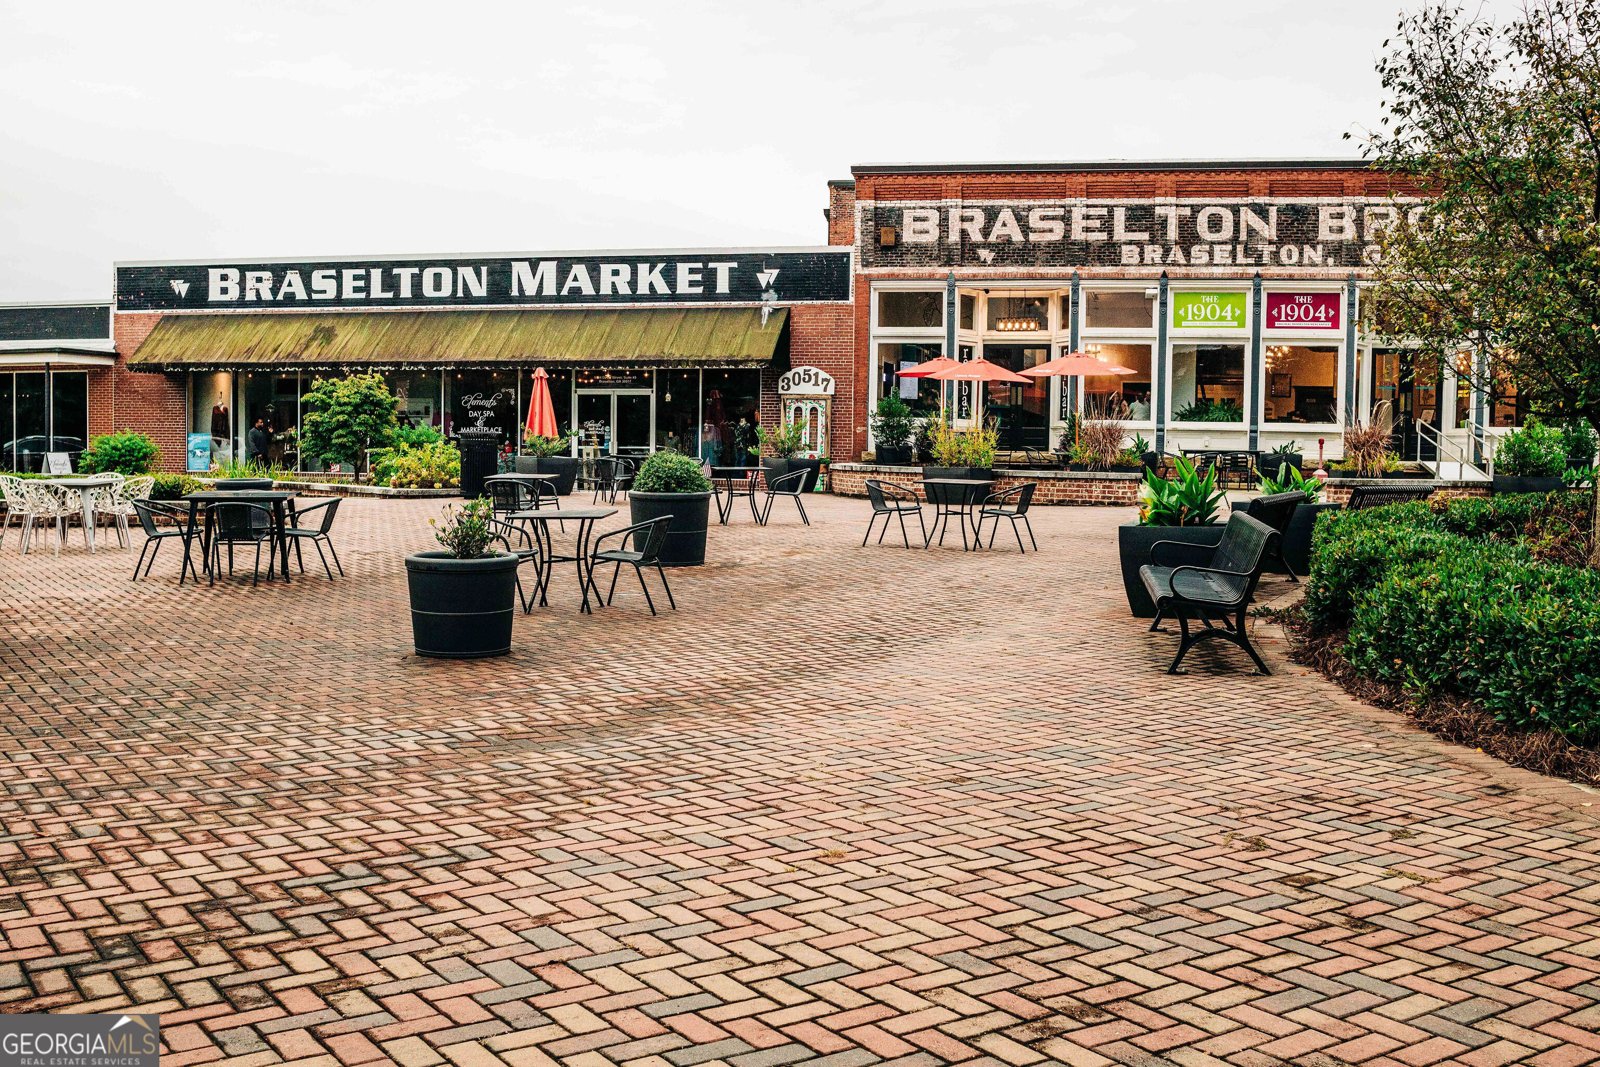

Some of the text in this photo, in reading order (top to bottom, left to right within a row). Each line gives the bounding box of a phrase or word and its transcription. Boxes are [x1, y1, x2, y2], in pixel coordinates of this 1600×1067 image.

[902, 206, 1279, 242] BRASELTON
[207, 261, 738, 302] BRASELTON MARKET
[1201, 295, 1219, 303] THE
[1294, 295, 1313, 303] THE
[1187, 303, 1233, 321] 1904
[1280, 303, 1326, 321] 1904
[781, 368, 831, 392] 30517
